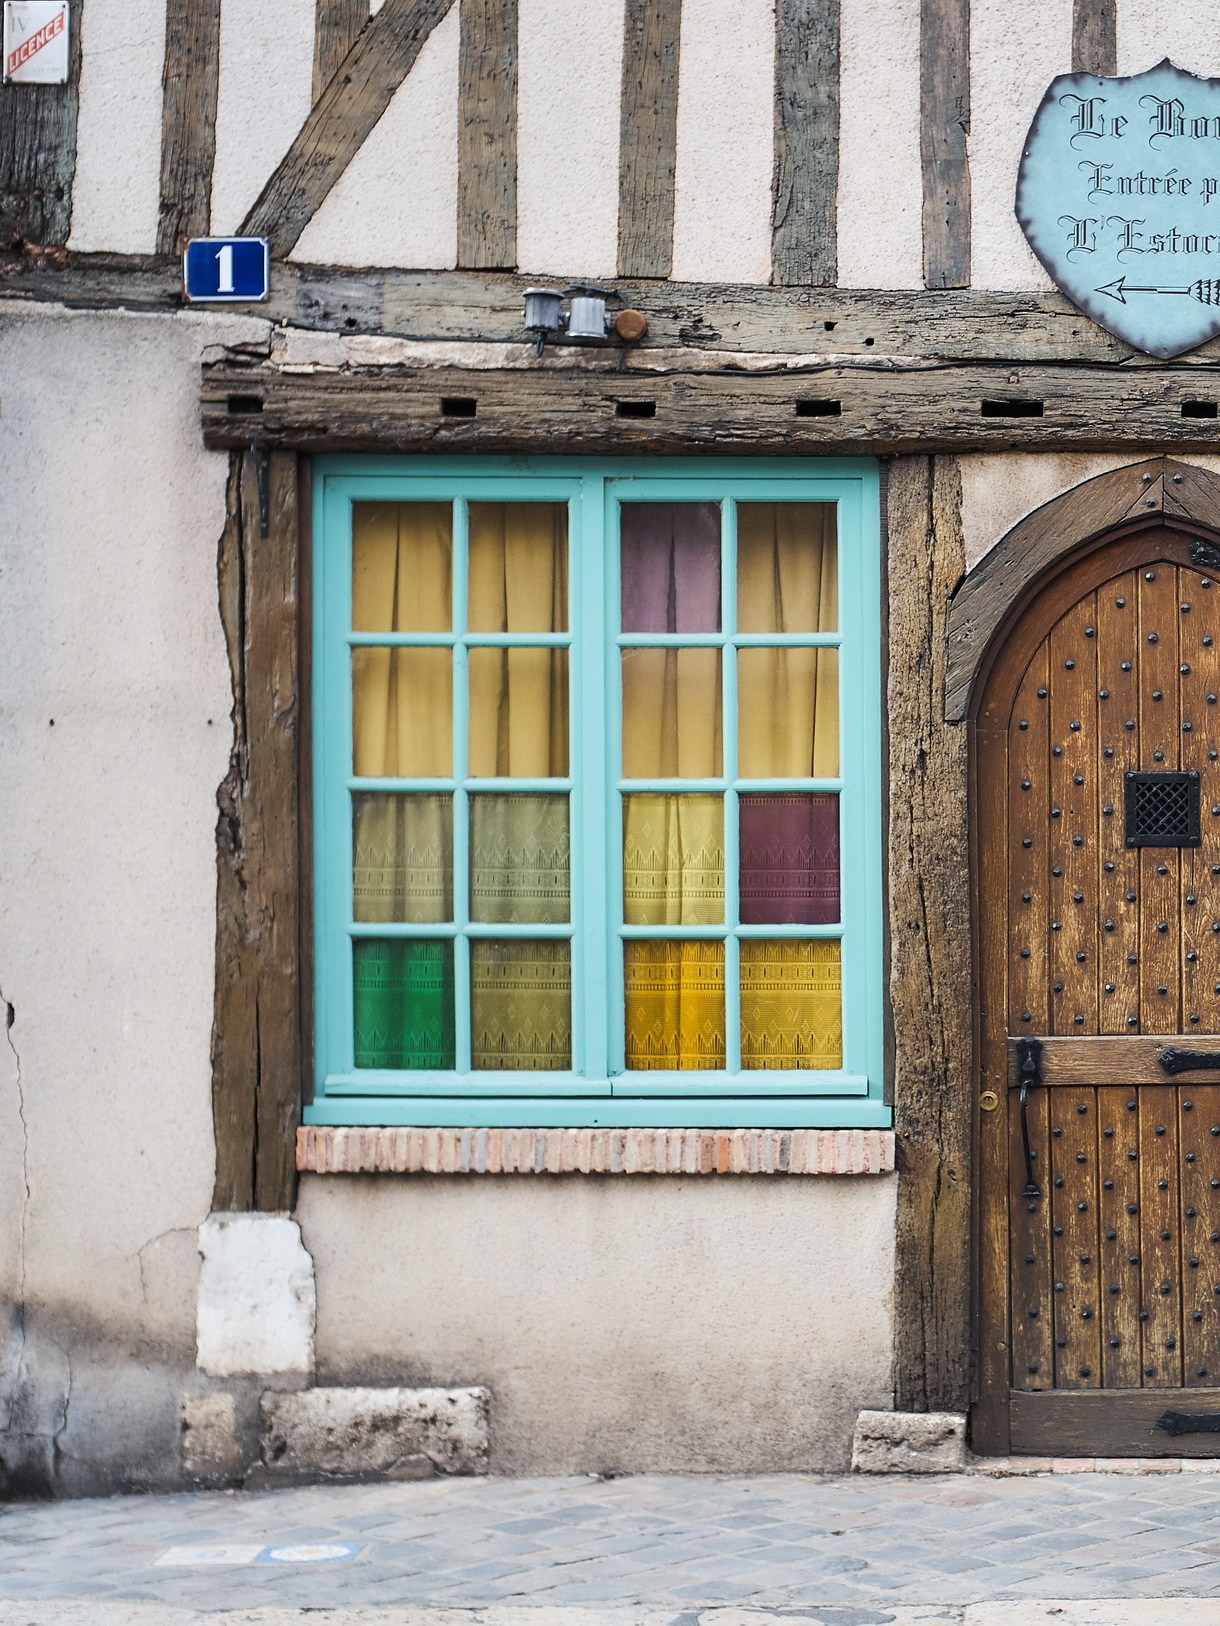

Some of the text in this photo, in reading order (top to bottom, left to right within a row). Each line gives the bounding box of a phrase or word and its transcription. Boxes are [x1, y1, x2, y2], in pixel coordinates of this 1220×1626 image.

[9, 15, 63, 71] LICENCE
[1059, 95, 1128, 151] Le
[1077, 160, 1192, 205] Entrée
[214, 244, 236, 293] 1
